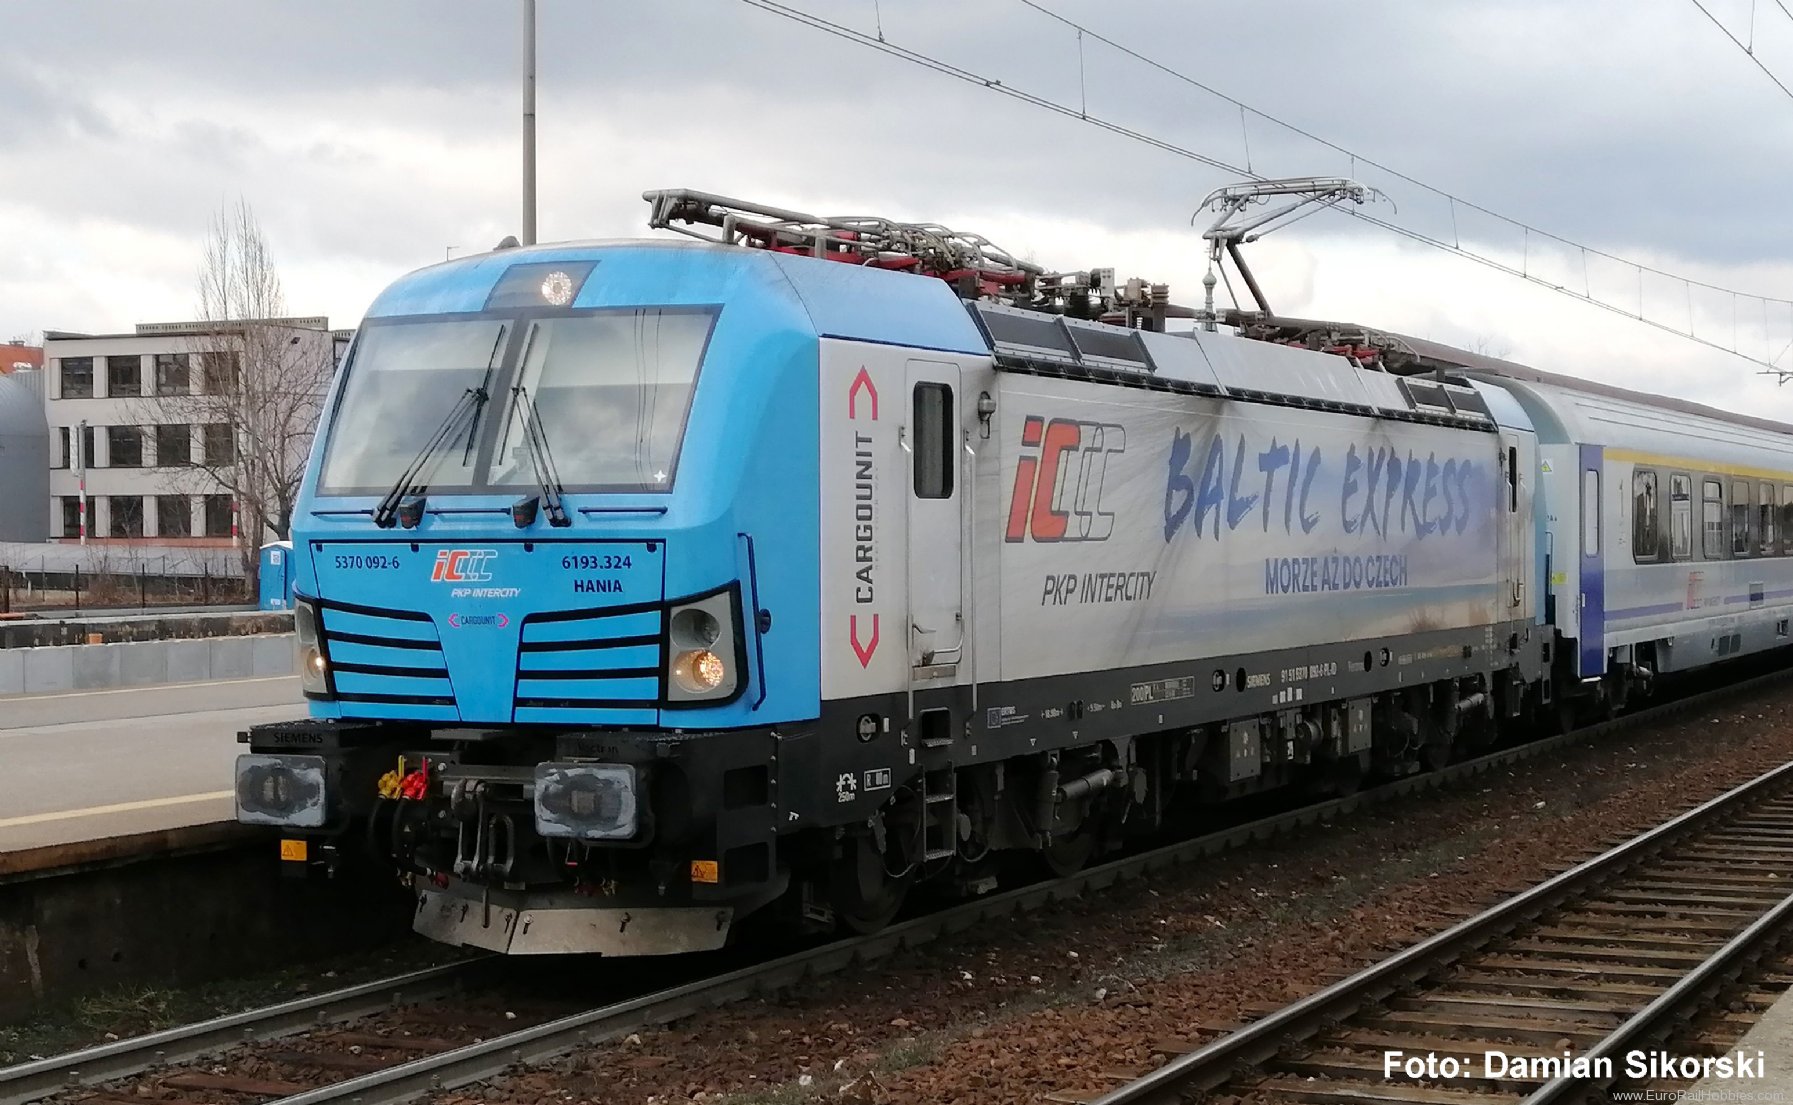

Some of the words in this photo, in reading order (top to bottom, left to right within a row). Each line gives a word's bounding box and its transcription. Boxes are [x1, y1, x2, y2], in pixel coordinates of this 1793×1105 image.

[1164, 426, 1321, 544] BALTIC
[1341, 443, 1471, 542] EXPRESS
[855, 431, 873, 603] CARGOUNIT
[335, 556, 362, 569] 5370
[365, 556, 400, 569] 092-6
[562, 555, 632, 569] 6193.324
[1265, 557, 1318, 594] MORZE
[1343, 555, 1363, 590] DO
[1365, 554, 1408, 588] CZECH
[574, 579, 623, 592] HANIA
[1041, 573, 1077, 606] PKP
[1079, 571, 1158, 604] INTERCITY
[451, 588, 472, 598] PKP
[473, 588, 521, 598] INTERCITY
[461, 615, 496, 625] CARGOUNIT
[273, 732, 323, 743] SIEMENS
